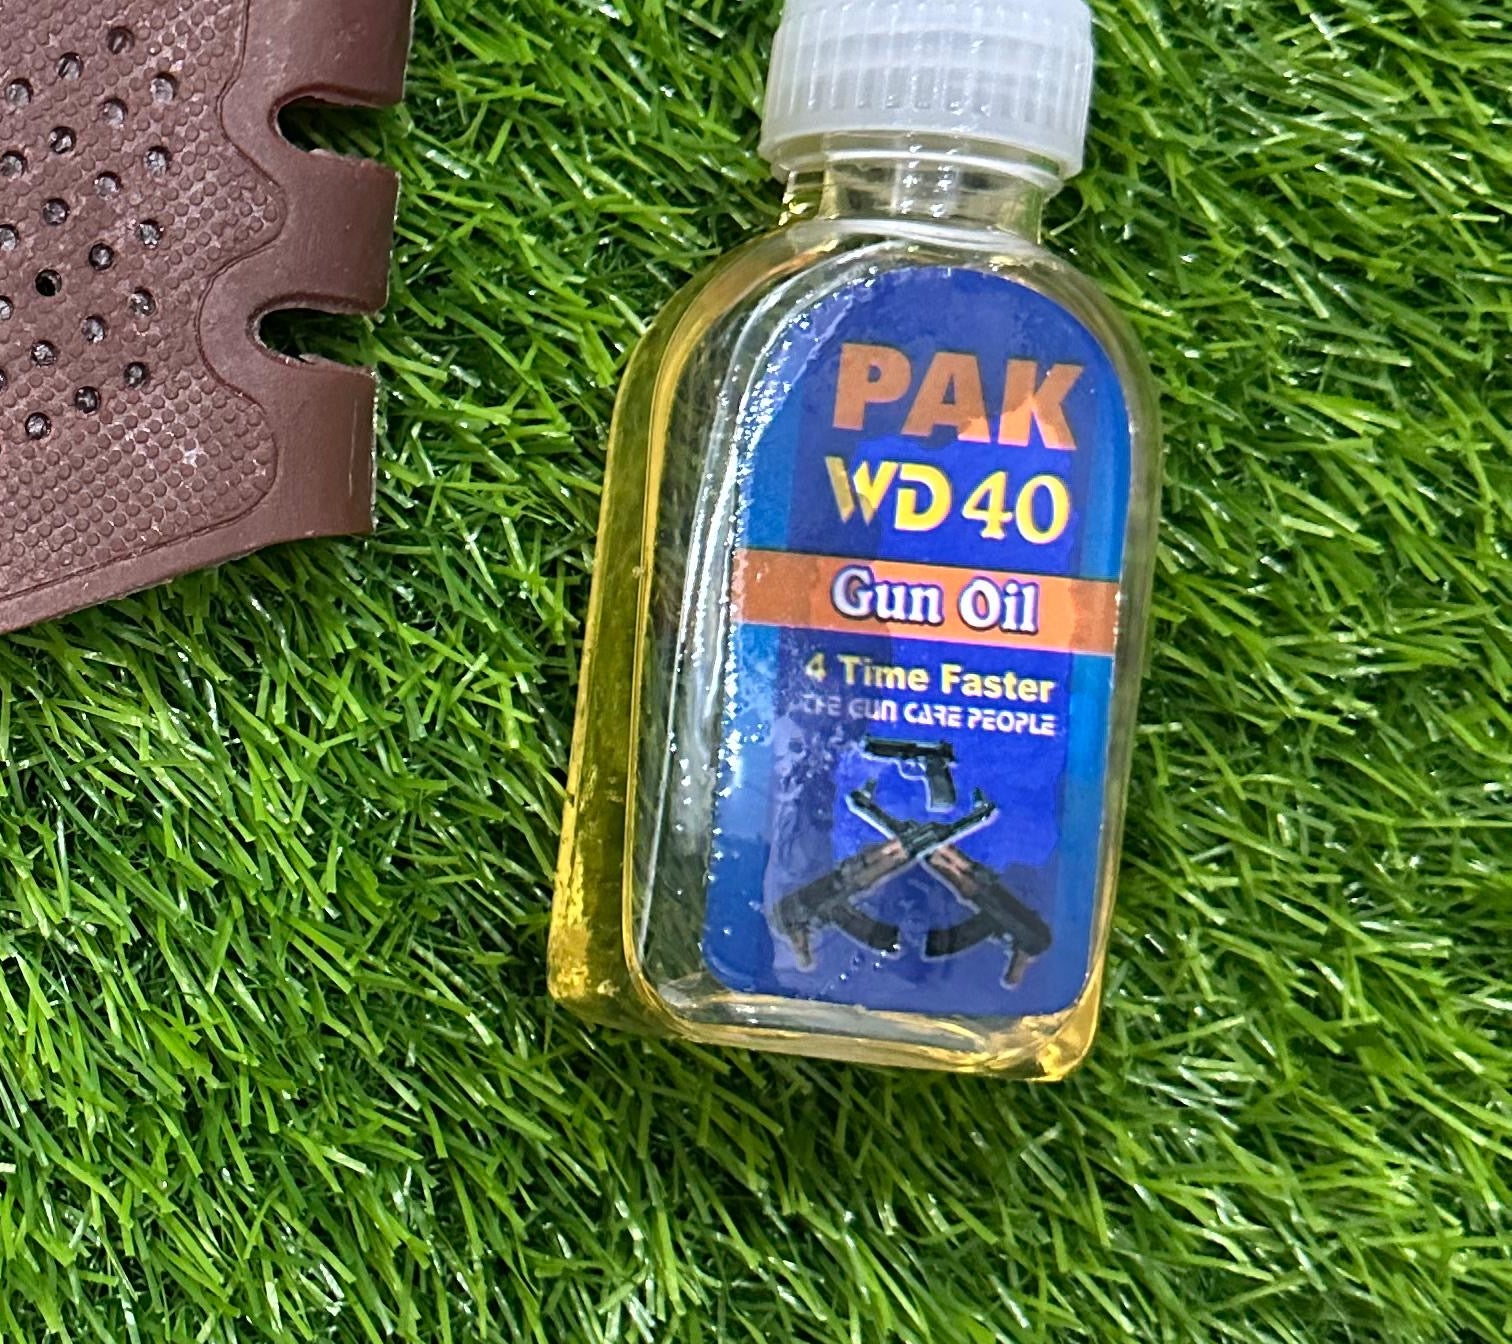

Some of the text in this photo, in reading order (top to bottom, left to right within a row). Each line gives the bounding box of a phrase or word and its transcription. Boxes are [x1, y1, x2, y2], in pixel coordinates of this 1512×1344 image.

[832, 342, 1083, 450] PAK
[825, 455, 1070, 544] WD 40
[831, 564, 1039, 634] Gun Oil
[805, 652, 1056, 703] 4 Time Faster
[803, 692, 1057, 736] THE GUN CARE PEOPLE
